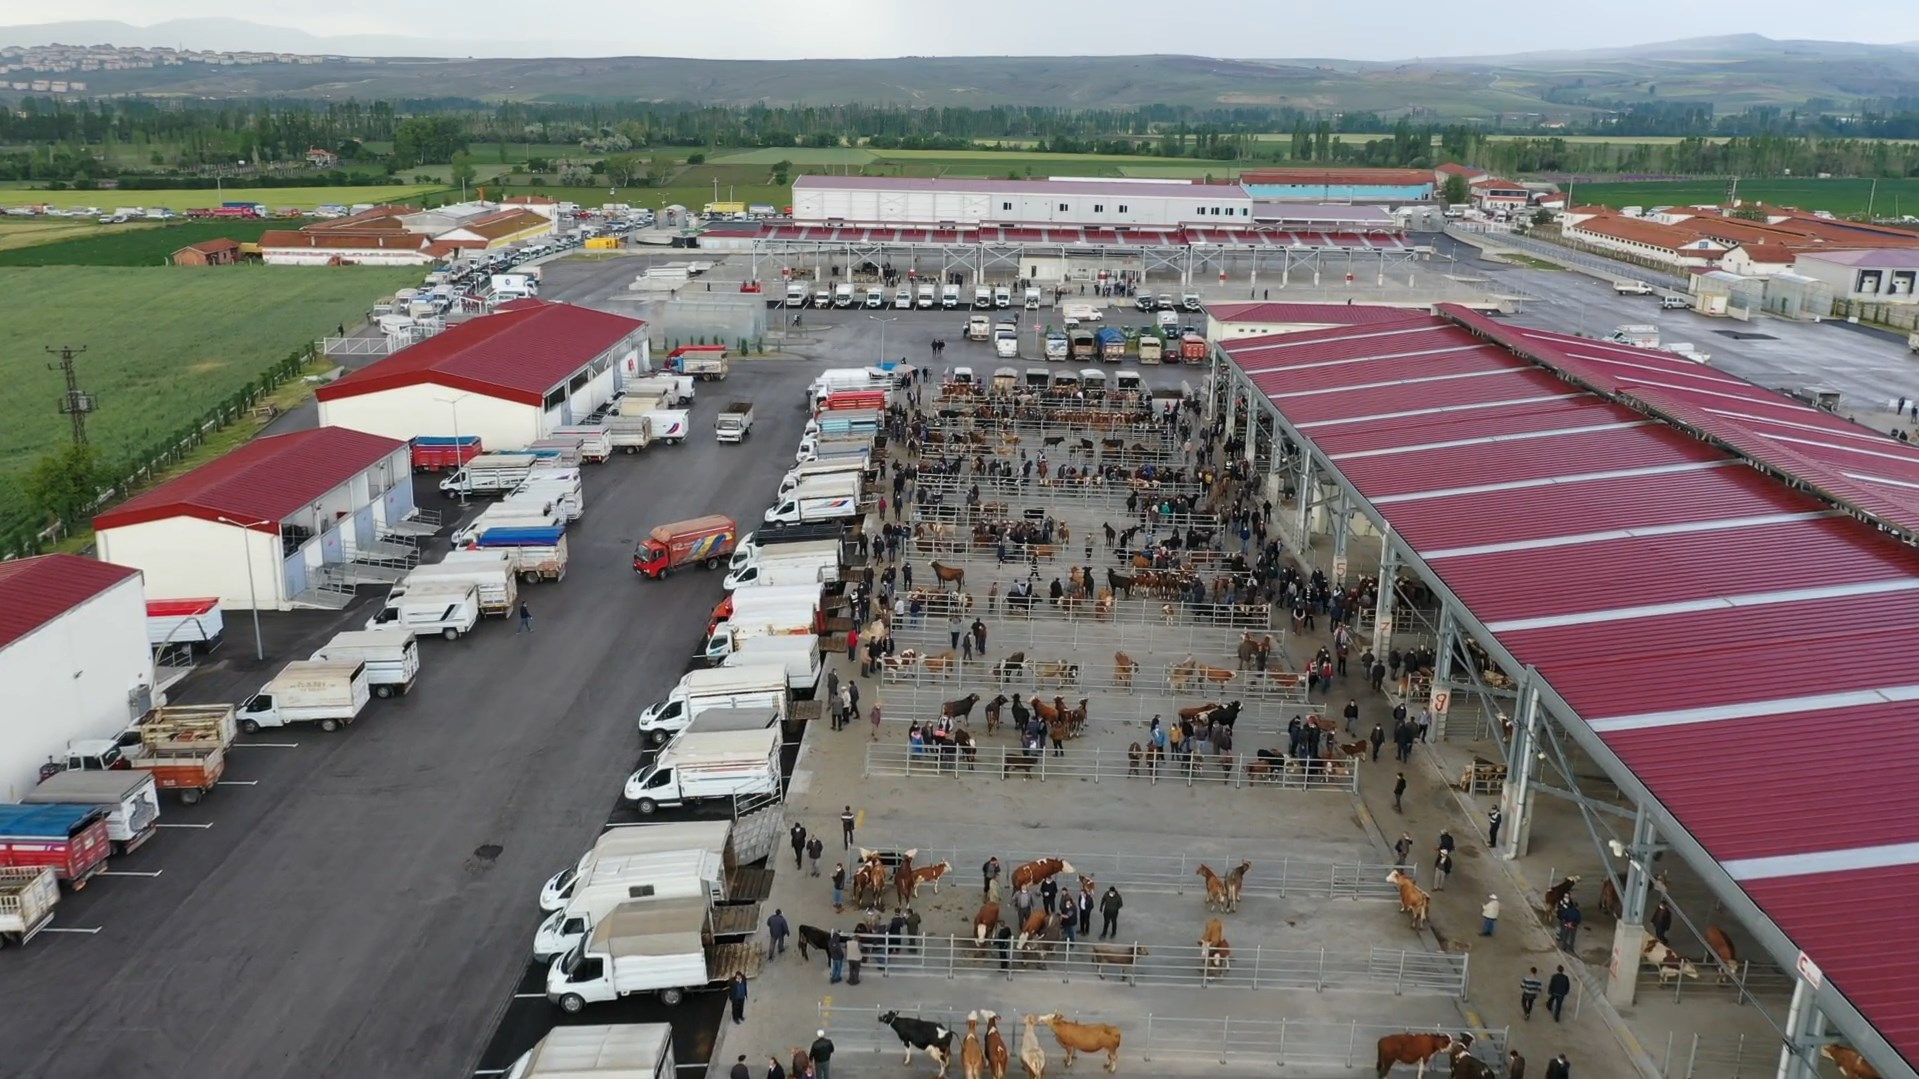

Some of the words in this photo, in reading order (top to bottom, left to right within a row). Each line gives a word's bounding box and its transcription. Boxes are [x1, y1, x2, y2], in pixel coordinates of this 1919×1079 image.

[1336, 562, 1346, 577] 5
[1380, 621, 1391, 634] 7
[1435, 693, 1447, 711] 9
